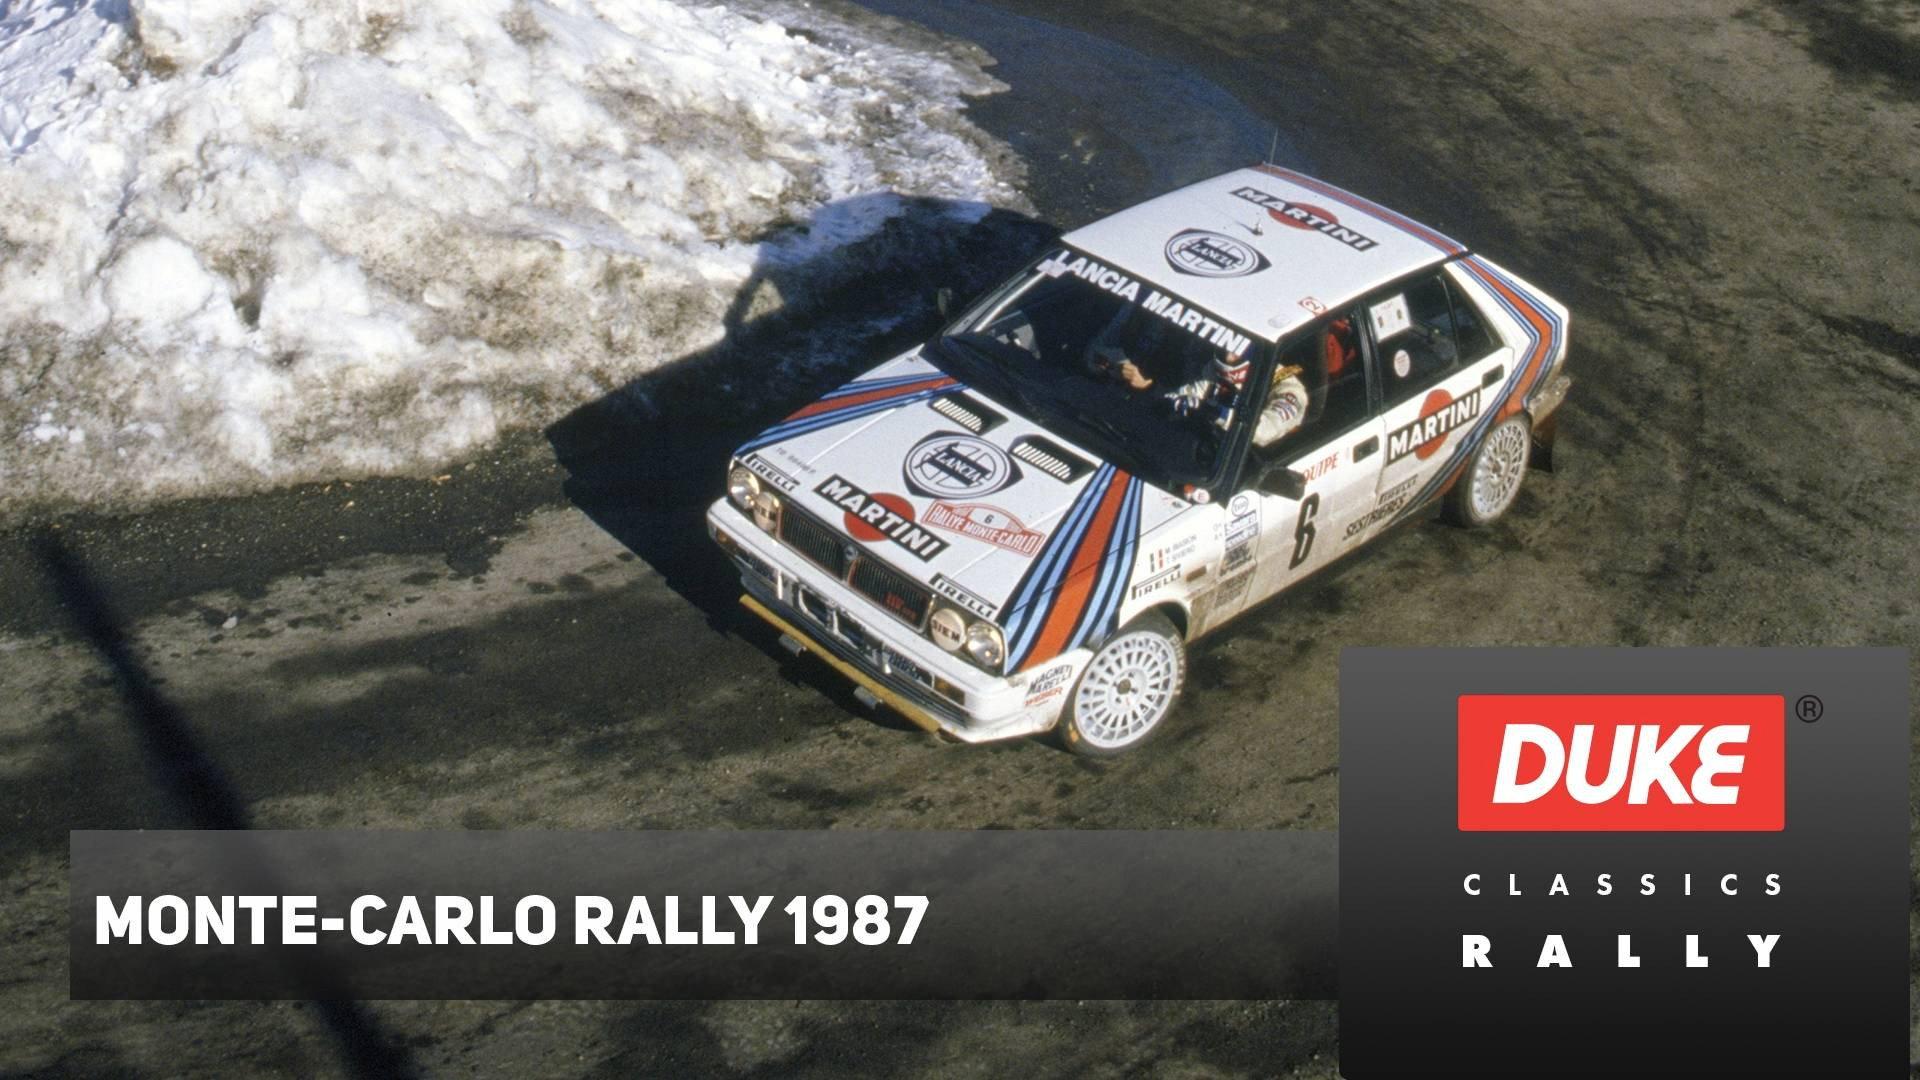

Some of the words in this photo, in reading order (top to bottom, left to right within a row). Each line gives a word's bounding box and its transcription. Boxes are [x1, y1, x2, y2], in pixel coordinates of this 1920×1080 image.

[1238, 188, 1372, 248] MARTINI
[1192, 243, 1236, 266] LANCIA
[1056, 250, 1141, 301] LANCIA
[1142, 290, 1251, 356] MARTINI
[1389, 391, 1478, 461] MARTINI
[745, 453, 801, 492] PIRELLI
[935, 452, 984, 482] LANCIA
[1302, 452, 1339, 481] QUIPE
[820, 477, 944, 557] MARTINI
[930, 505, 964, 531] RALLYE
[964, 519, 1039, 553] MONTE-CARLO
[984, 514, 994, 524] 6
[1288, 492, 1320, 570] 6
[928, 571, 998, 619] PIRELLI
[1131, 563, 1182, 601] PIRELLI
